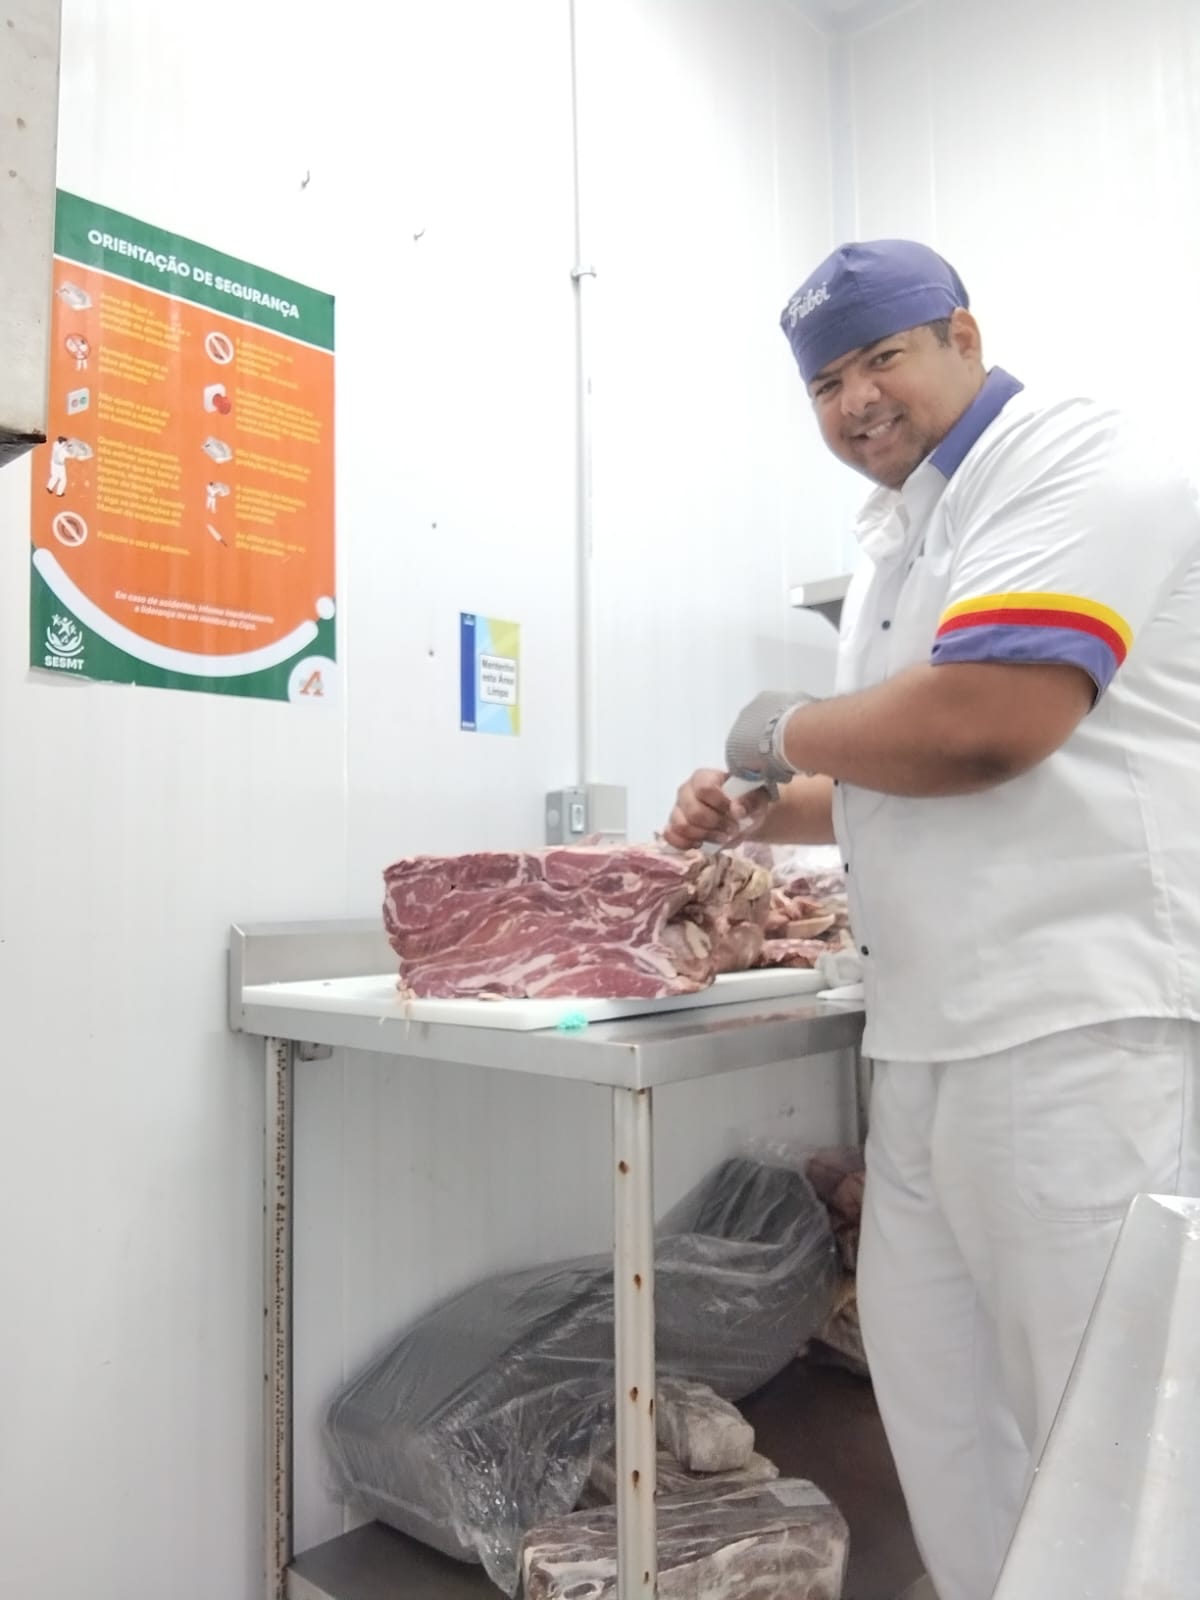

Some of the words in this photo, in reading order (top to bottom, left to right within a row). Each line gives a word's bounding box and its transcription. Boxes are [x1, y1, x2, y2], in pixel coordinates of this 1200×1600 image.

[87, 229, 191, 278] ORIENTAÇÃO
[192, 266, 214, 287] DE
[214, 275, 300, 319] SEGURANÇA
[44, 655, 85, 670] SESMT
